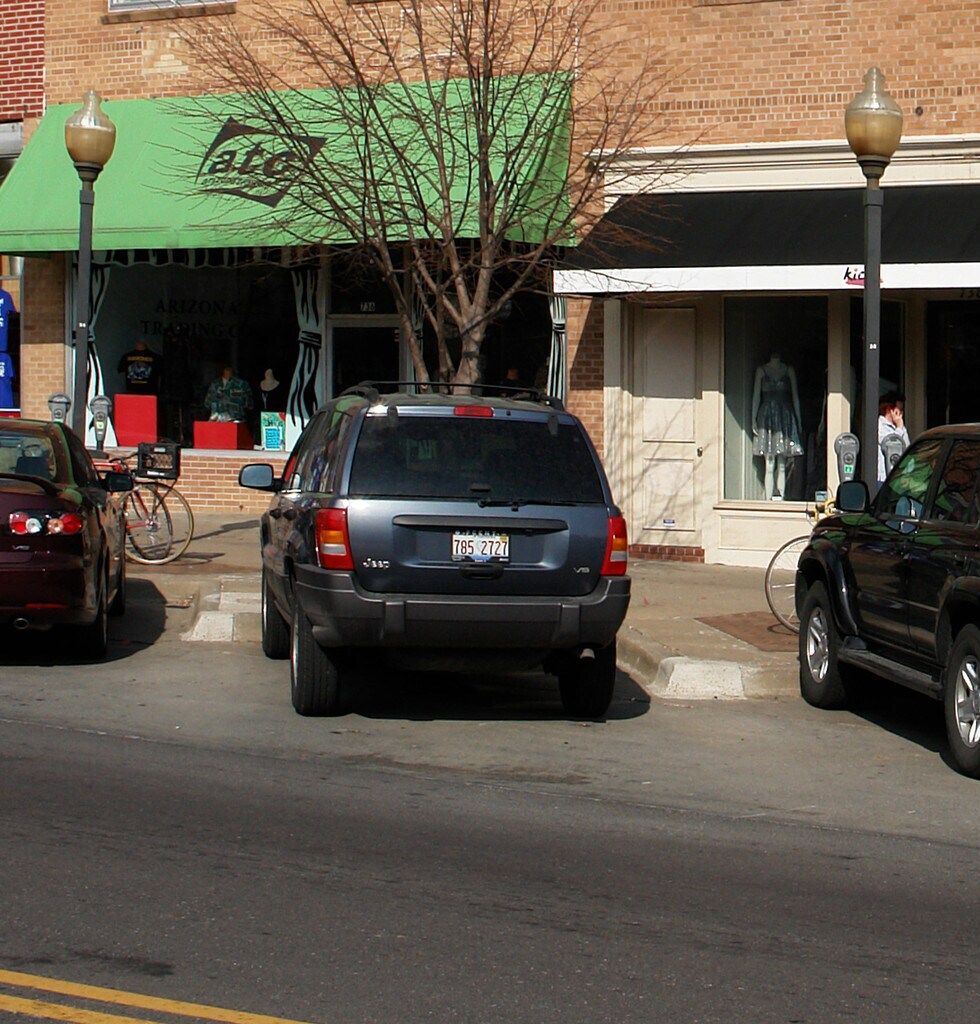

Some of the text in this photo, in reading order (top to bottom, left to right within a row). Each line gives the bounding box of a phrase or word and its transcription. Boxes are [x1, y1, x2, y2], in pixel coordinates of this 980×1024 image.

[155, 299, 239, 315] ARIZONA
[140, 320, 224, 337] TRADING
[454, 539, 508, 556] 785 2727
